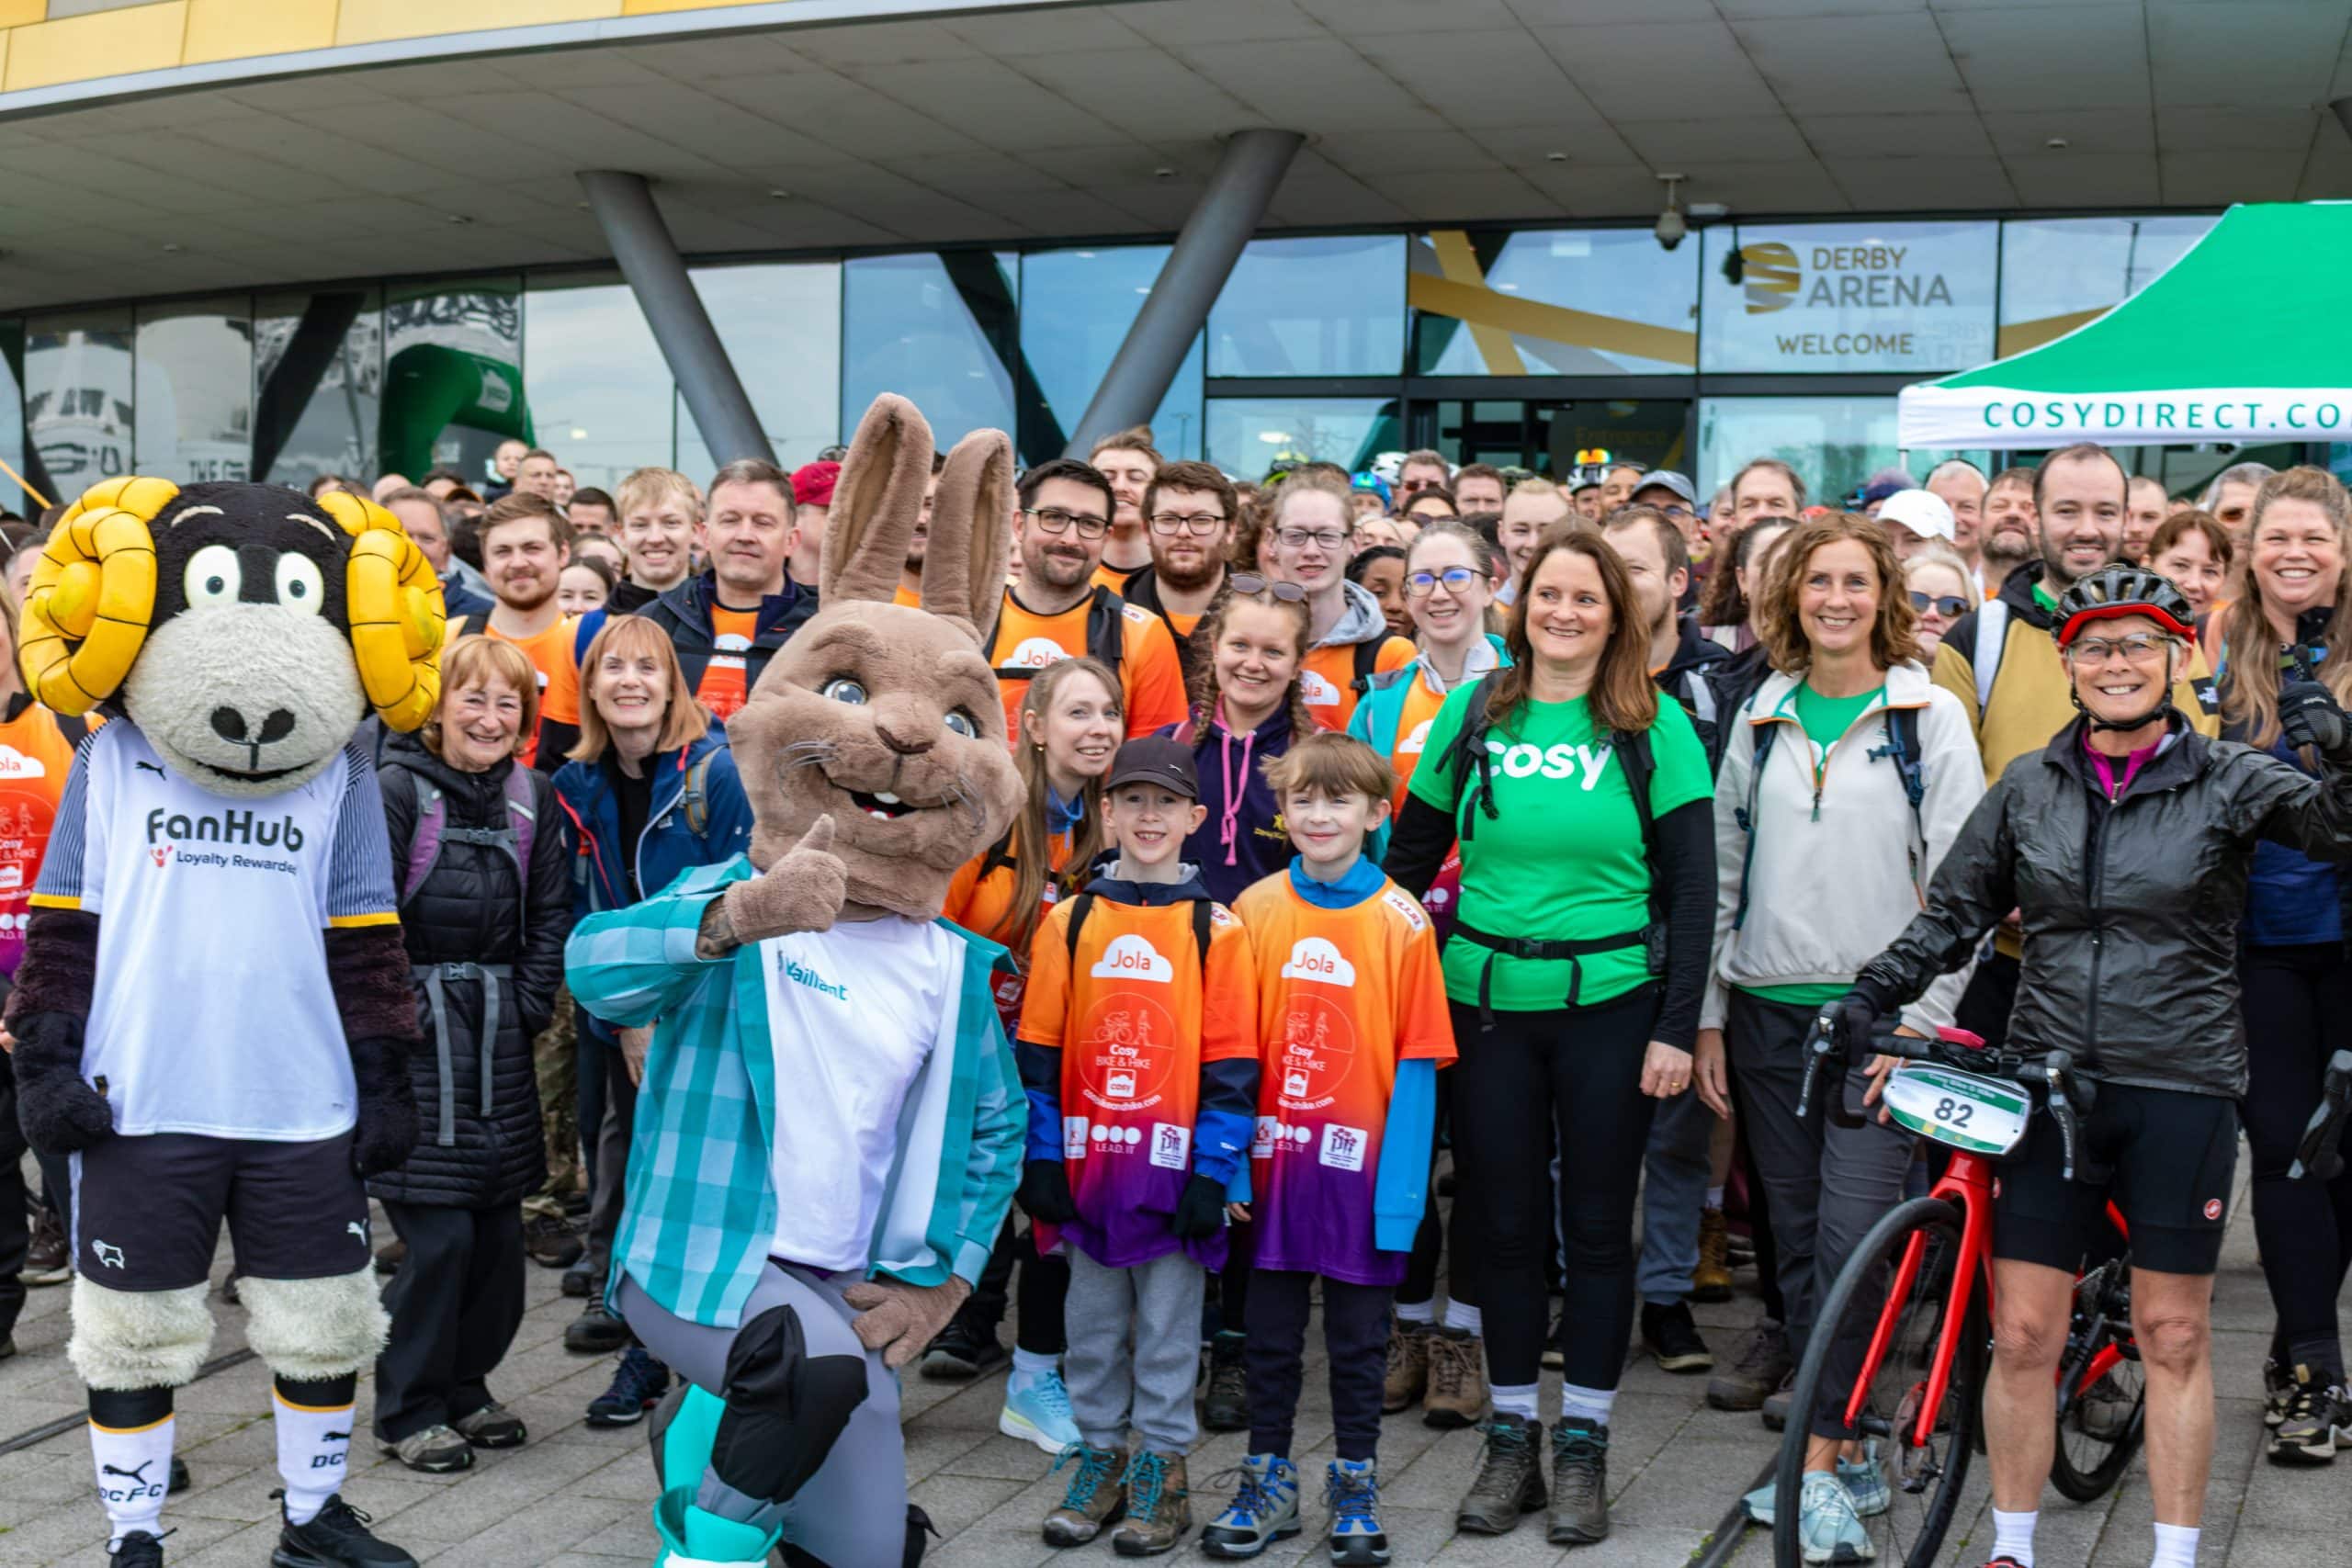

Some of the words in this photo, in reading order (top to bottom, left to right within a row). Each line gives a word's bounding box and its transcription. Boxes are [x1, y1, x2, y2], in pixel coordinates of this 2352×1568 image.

[1812, 246, 1907, 270] DERBY
[1806, 275, 1952, 307] ARENA
[1776, 333, 1914, 355] WELCOME
[1984, 402, 2352, 430] COSYDIRECT.CO
[1476, 740, 1612, 791] cosy
[176, 851, 228, 868] Loyalty
[1110, 949, 1151, 971] Jola
[1294, 951, 1334, 974] Jola
[786, 957, 848, 1001] Vaillant
[1109, 1043, 1139, 1058] Cosy
[1128, 1058, 1151, 1069] HIKE
[1934, 1098, 1973, 1128] 82
[311, 1451, 347, 1469] DC
[99, 1483, 163, 1502] DCFC
